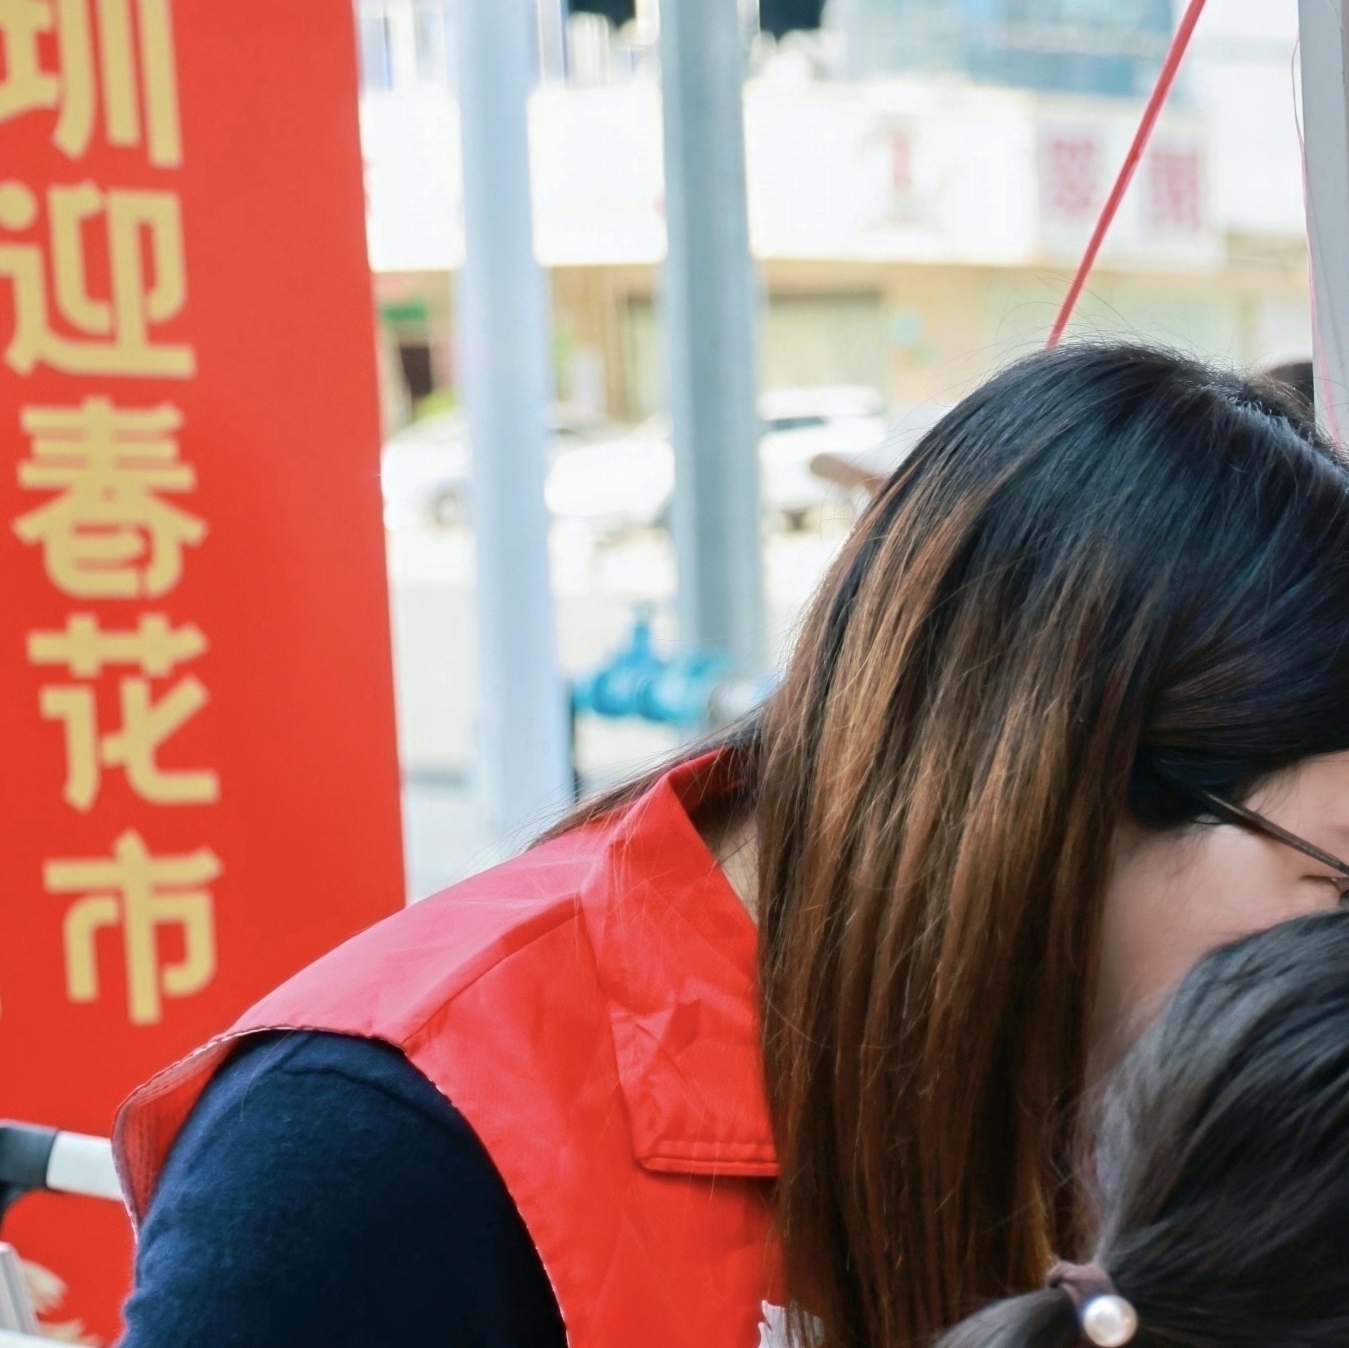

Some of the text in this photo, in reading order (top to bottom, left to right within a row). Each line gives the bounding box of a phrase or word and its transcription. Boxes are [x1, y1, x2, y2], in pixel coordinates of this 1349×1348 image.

[0, 0, 222, 1026] 圳迎春花市
